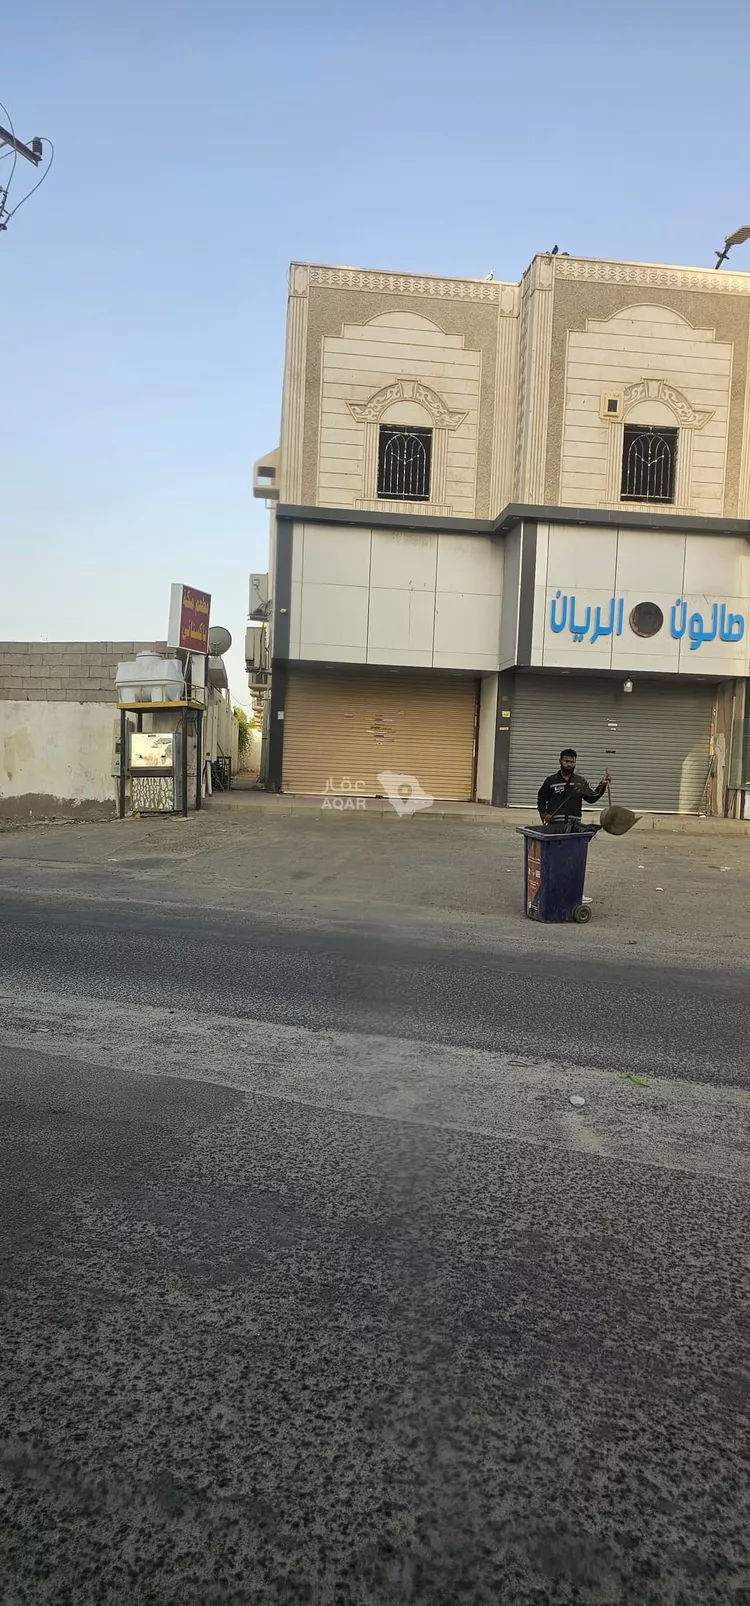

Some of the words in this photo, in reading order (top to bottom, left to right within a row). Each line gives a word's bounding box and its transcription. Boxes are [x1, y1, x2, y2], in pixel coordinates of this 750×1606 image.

[195, 596, 209, 616] مطعم
[550, 590, 624, 644] الريان
[670, 598, 745, 650] صالون
[182, 620, 207, 645] باكستاني
